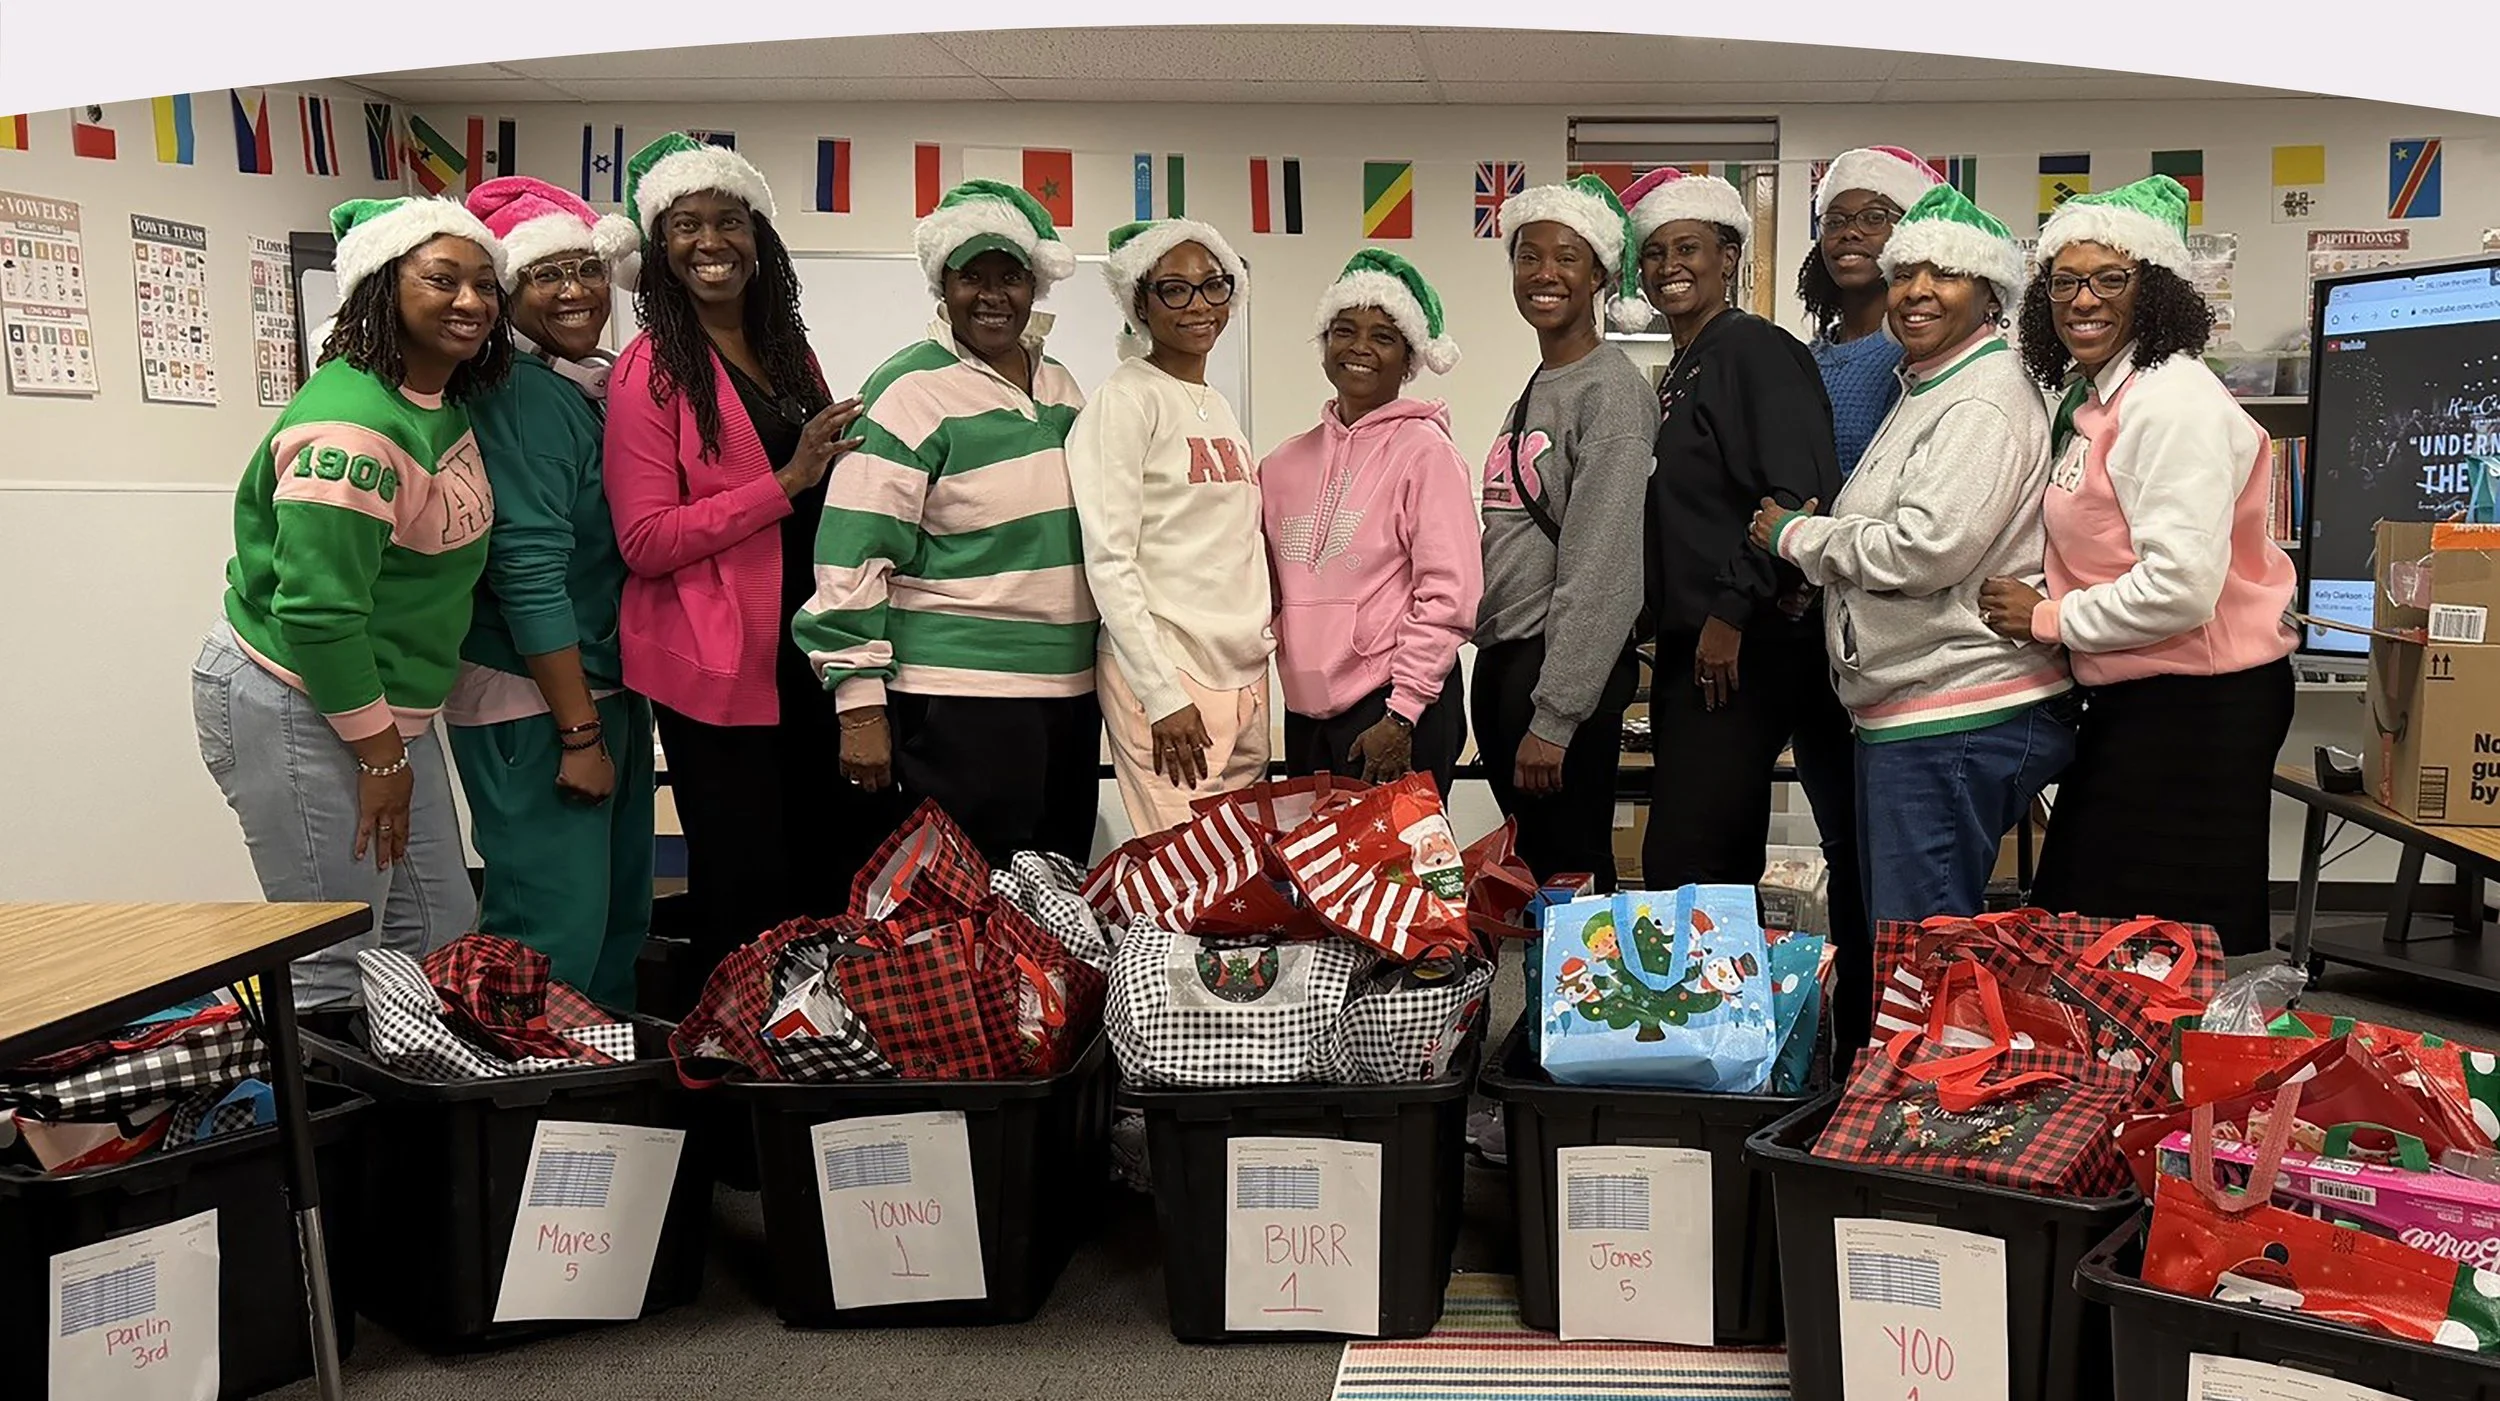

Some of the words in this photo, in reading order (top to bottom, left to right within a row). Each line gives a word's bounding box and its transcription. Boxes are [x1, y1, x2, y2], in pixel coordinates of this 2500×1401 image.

[6, 197, 67, 221] VOWELS
[133, 218, 169, 236] VOWEL
[172, 227, 203, 241] TEAMS
[2317, 233, 2401, 245] DIPHTHONGS
[256, 239, 282, 253] FLOSS
[261, 328, 281, 339] SOFT
[2417, 463, 2470, 494] THE
[2315, 591, 2331, 600] Kelly
[2333, 591, 2362, 600] Clarkson
[2471, 781, 2499, 805] by
[862, 1198, 941, 1229] YOUNG
[537, 1223, 613, 1255] Mares
[1265, 1223, 1352, 1267] BURR
[2399, 1227, 2500, 1273] Barbie
[892, 1235, 930, 1277] 1
[1590, 1243, 1653, 1270] Jones
[564, 1262, 579, 1281] 5
[1619, 1279, 1636, 1302] 5
[131, 1339, 168, 1369] 3rd
[1883, 1326, 1954, 1381] YOO
